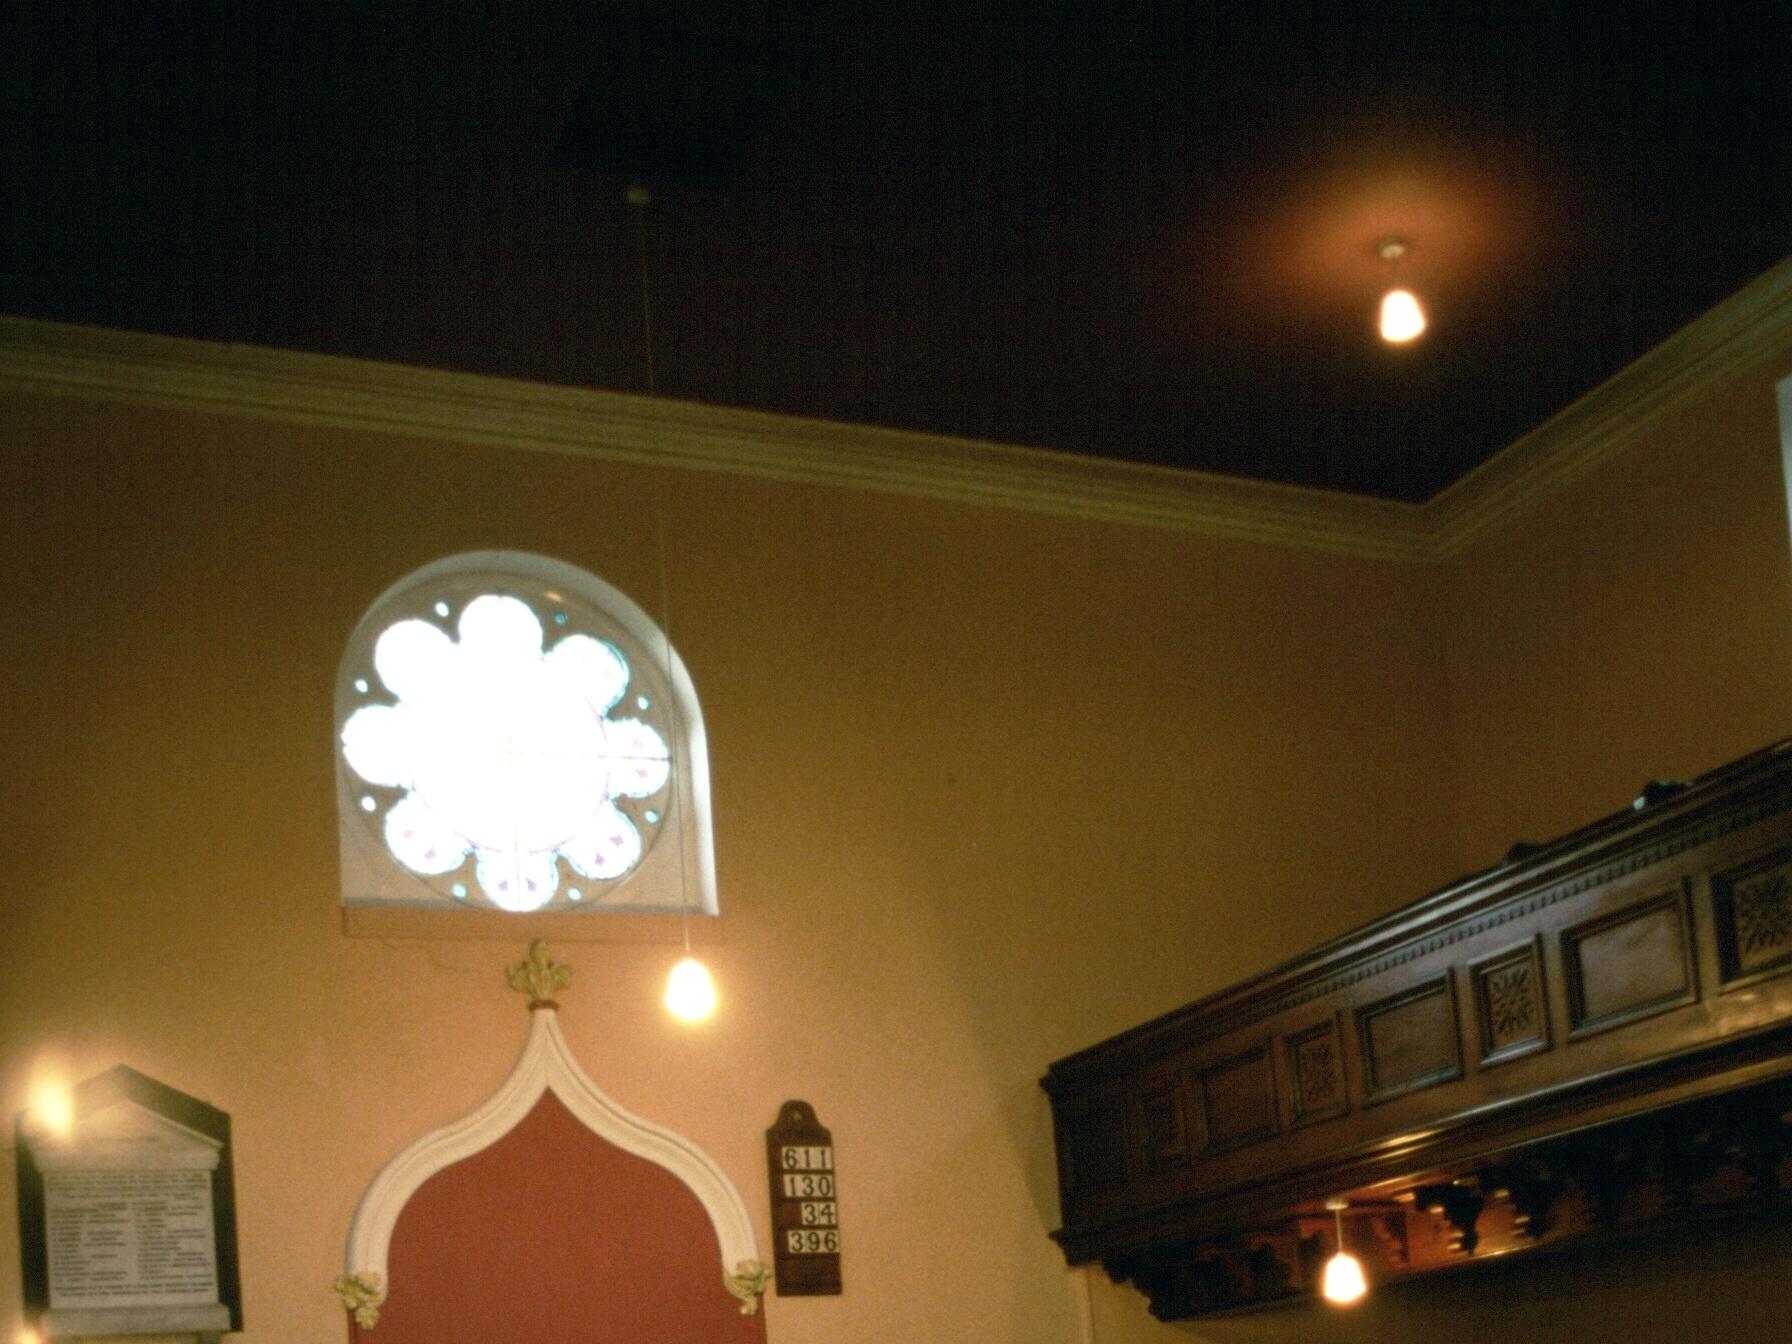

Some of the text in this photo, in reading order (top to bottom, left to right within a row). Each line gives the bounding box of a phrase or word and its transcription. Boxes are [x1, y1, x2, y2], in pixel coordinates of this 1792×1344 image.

[785, 1148, 827, 1168] 611
[789, 1176, 831, 1197] 130
[804, 1204, 834, 1224] 34
[791, 1232, 838, 1252] 396
